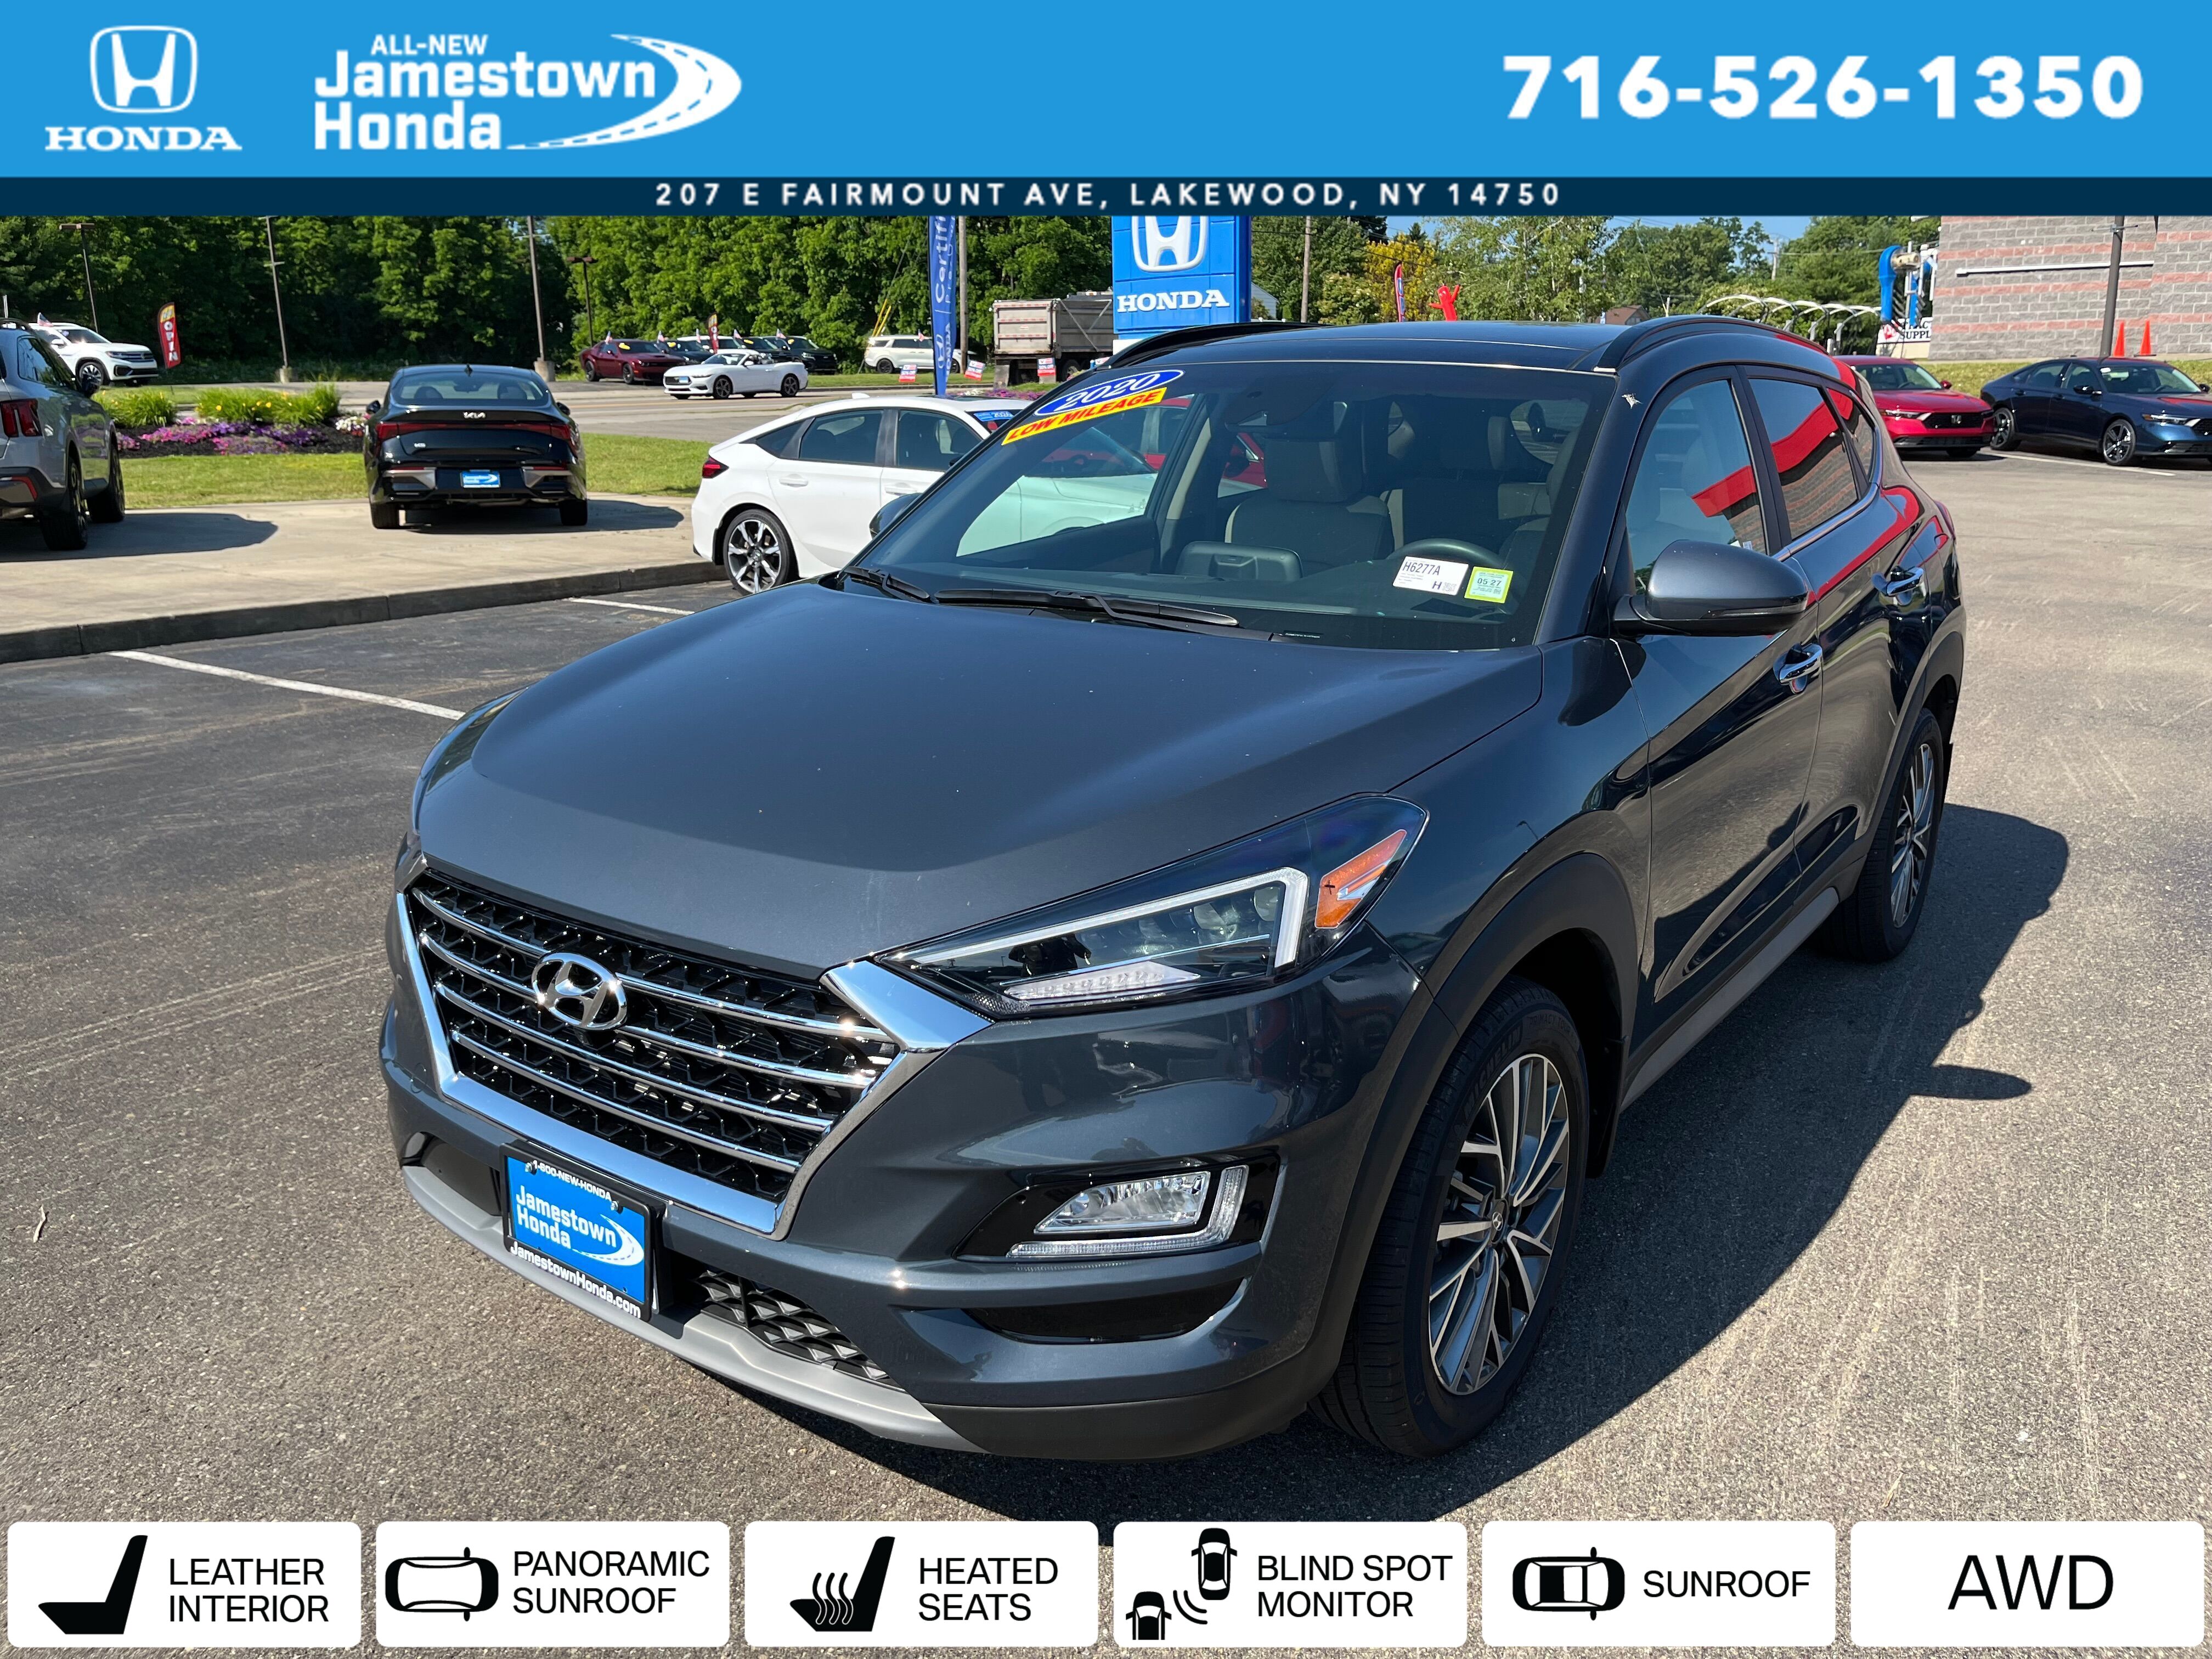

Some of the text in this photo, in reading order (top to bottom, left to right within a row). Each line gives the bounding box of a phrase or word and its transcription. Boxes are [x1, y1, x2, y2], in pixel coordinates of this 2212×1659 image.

[1117, 290, 1230, 313] HONDA
[1053, 373, 1161, 412] 2020
[1008, 390, 1161, 441] LOW MILEAGE
[1402, 561, 1441, 575] H6277A
[533, 1160, 613, 1201] 1-800-NEW-HONDA
[516, 1185, 617, 1248] Jamestown
[516, 1204, 572, 1249] Honda
[510, 1241, 641, 1319] JamestownHonda.com
